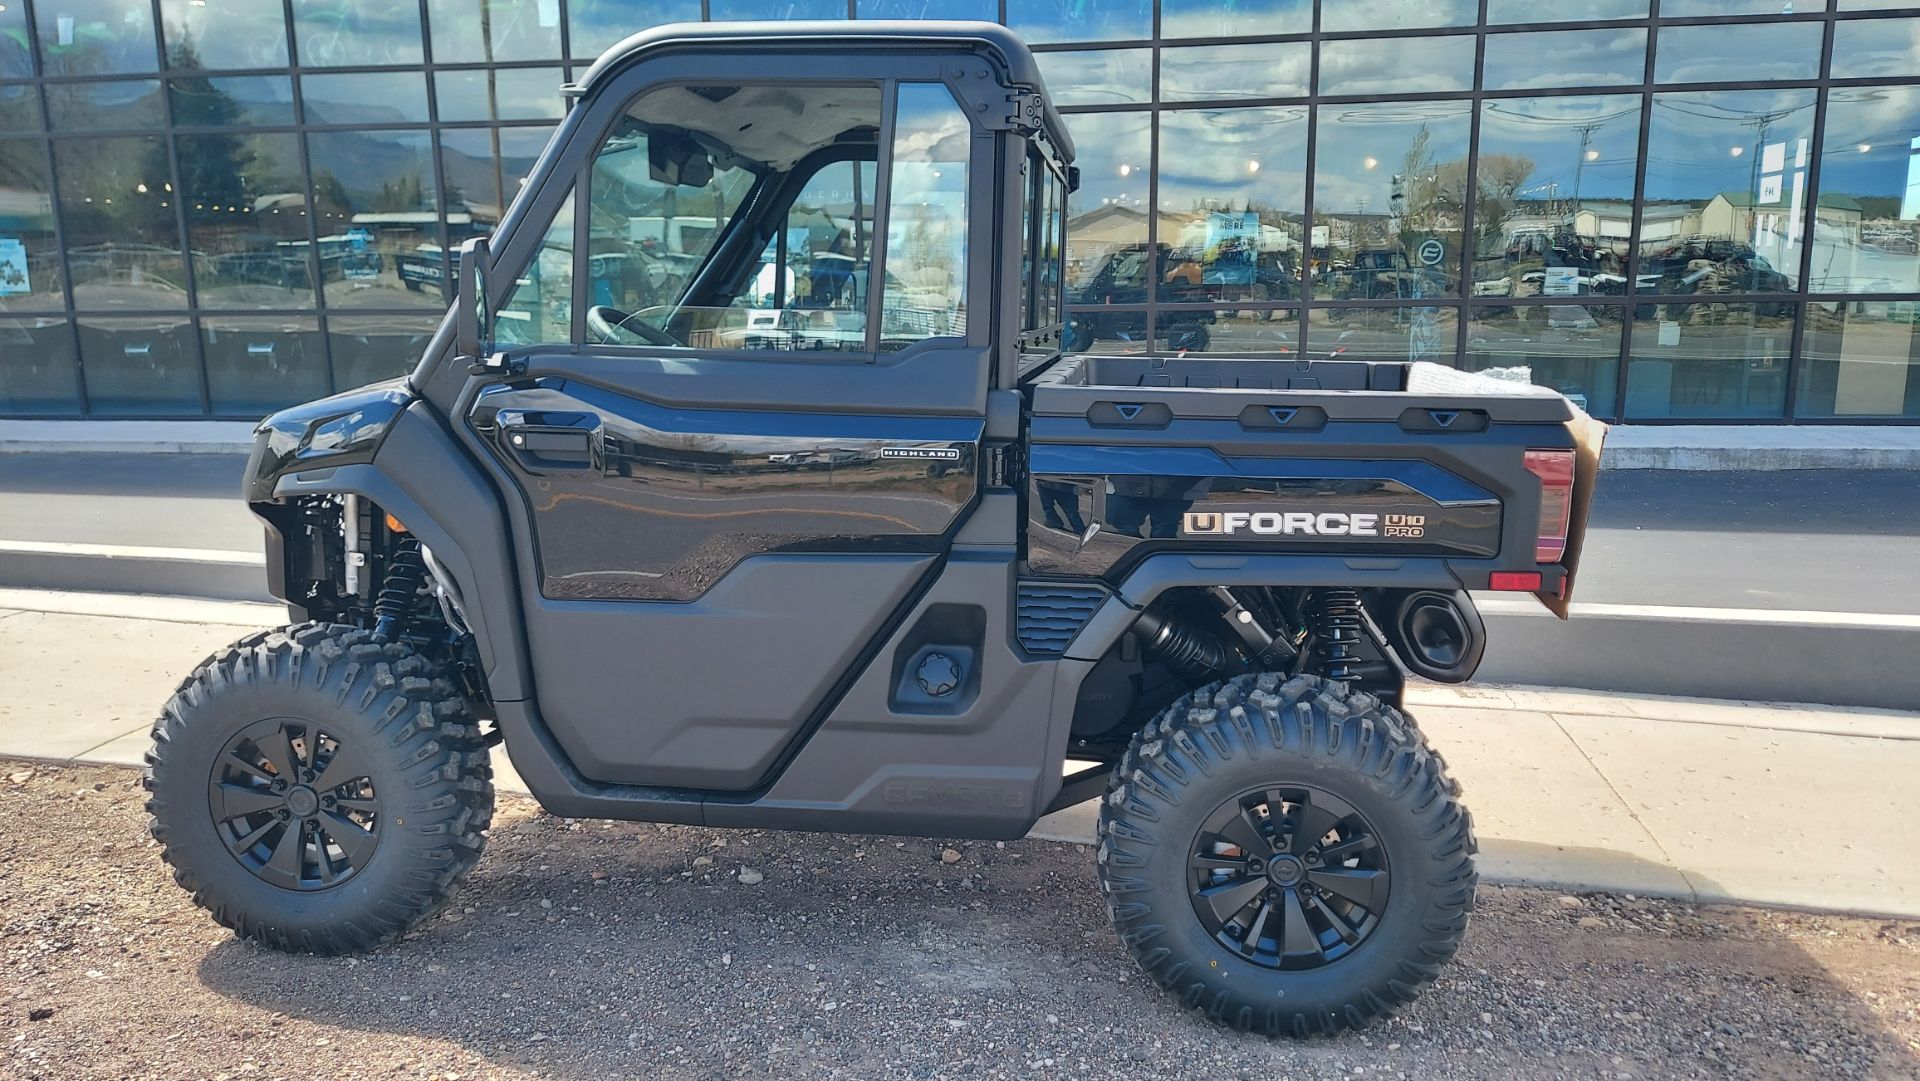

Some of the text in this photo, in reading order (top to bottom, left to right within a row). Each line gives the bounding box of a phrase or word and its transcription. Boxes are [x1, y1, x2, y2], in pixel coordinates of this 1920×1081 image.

[884, 450, 956, 458] HIGHLAND
[1385, 514, 1425, 526] U10
[1384, 526, 1424, 537] PRO
